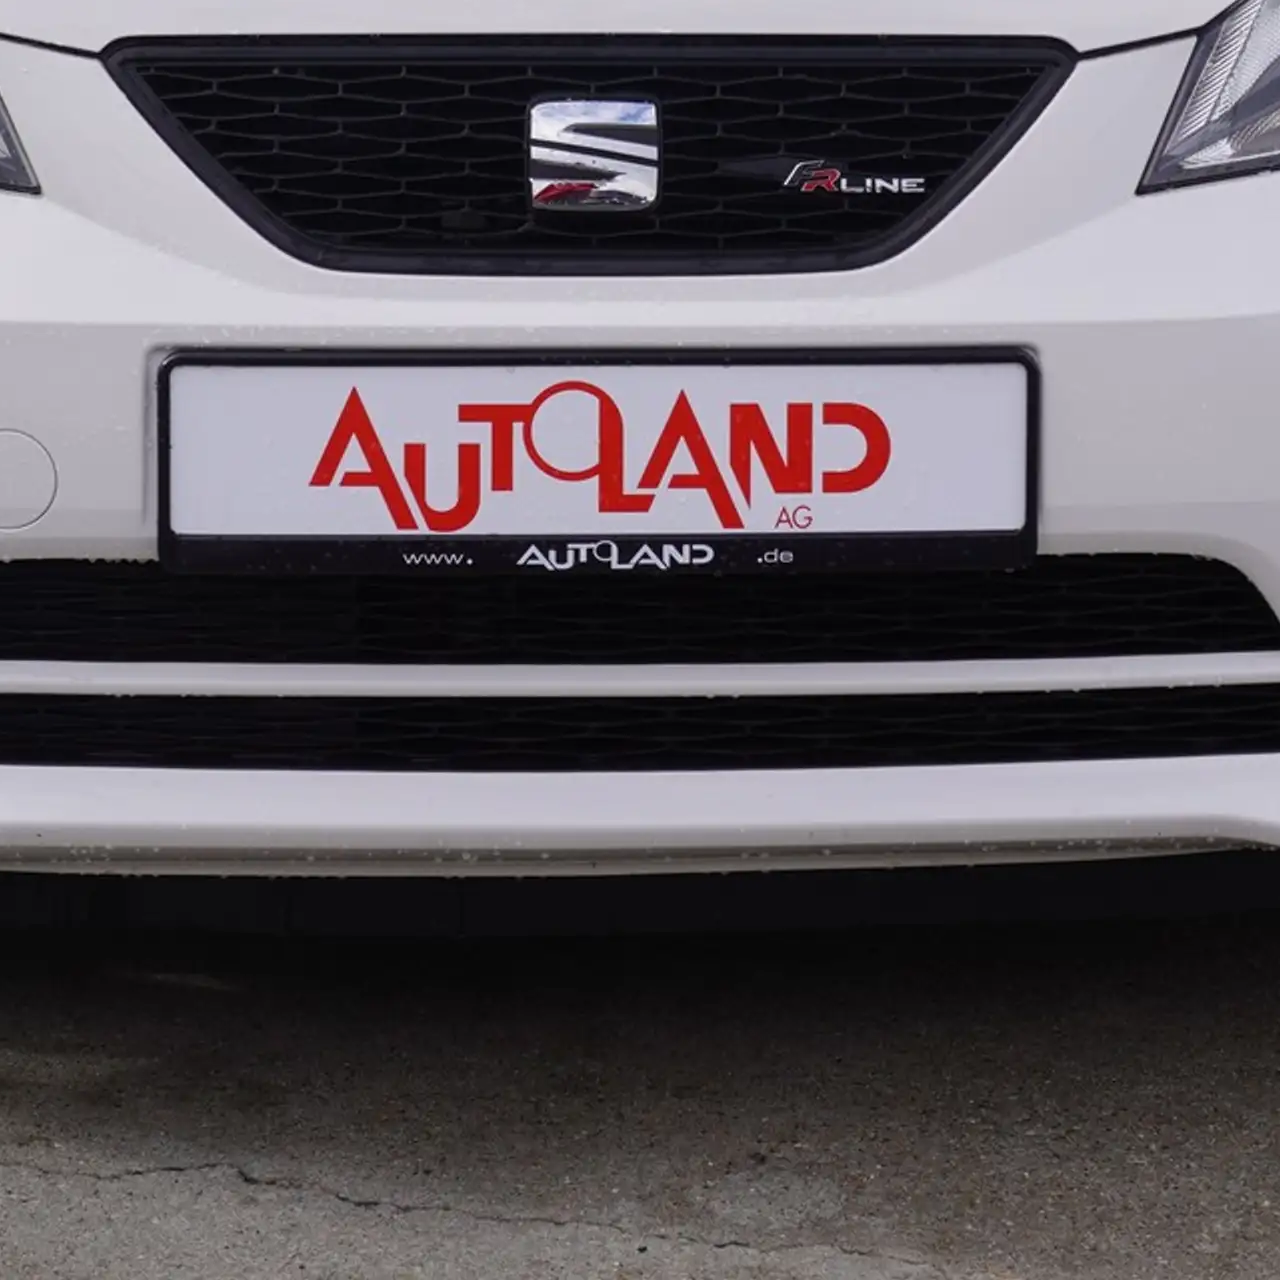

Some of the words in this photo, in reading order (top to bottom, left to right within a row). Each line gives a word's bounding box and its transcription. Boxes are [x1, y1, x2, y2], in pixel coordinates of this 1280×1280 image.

[309, 380, 891, 532] AUTOLAND
[774, 505, 813, 529] AG
[402, 551, 474, 566] www.
[516, 539, 715, 571] AUTOLAND
[756, 548, 794, 565] .de
